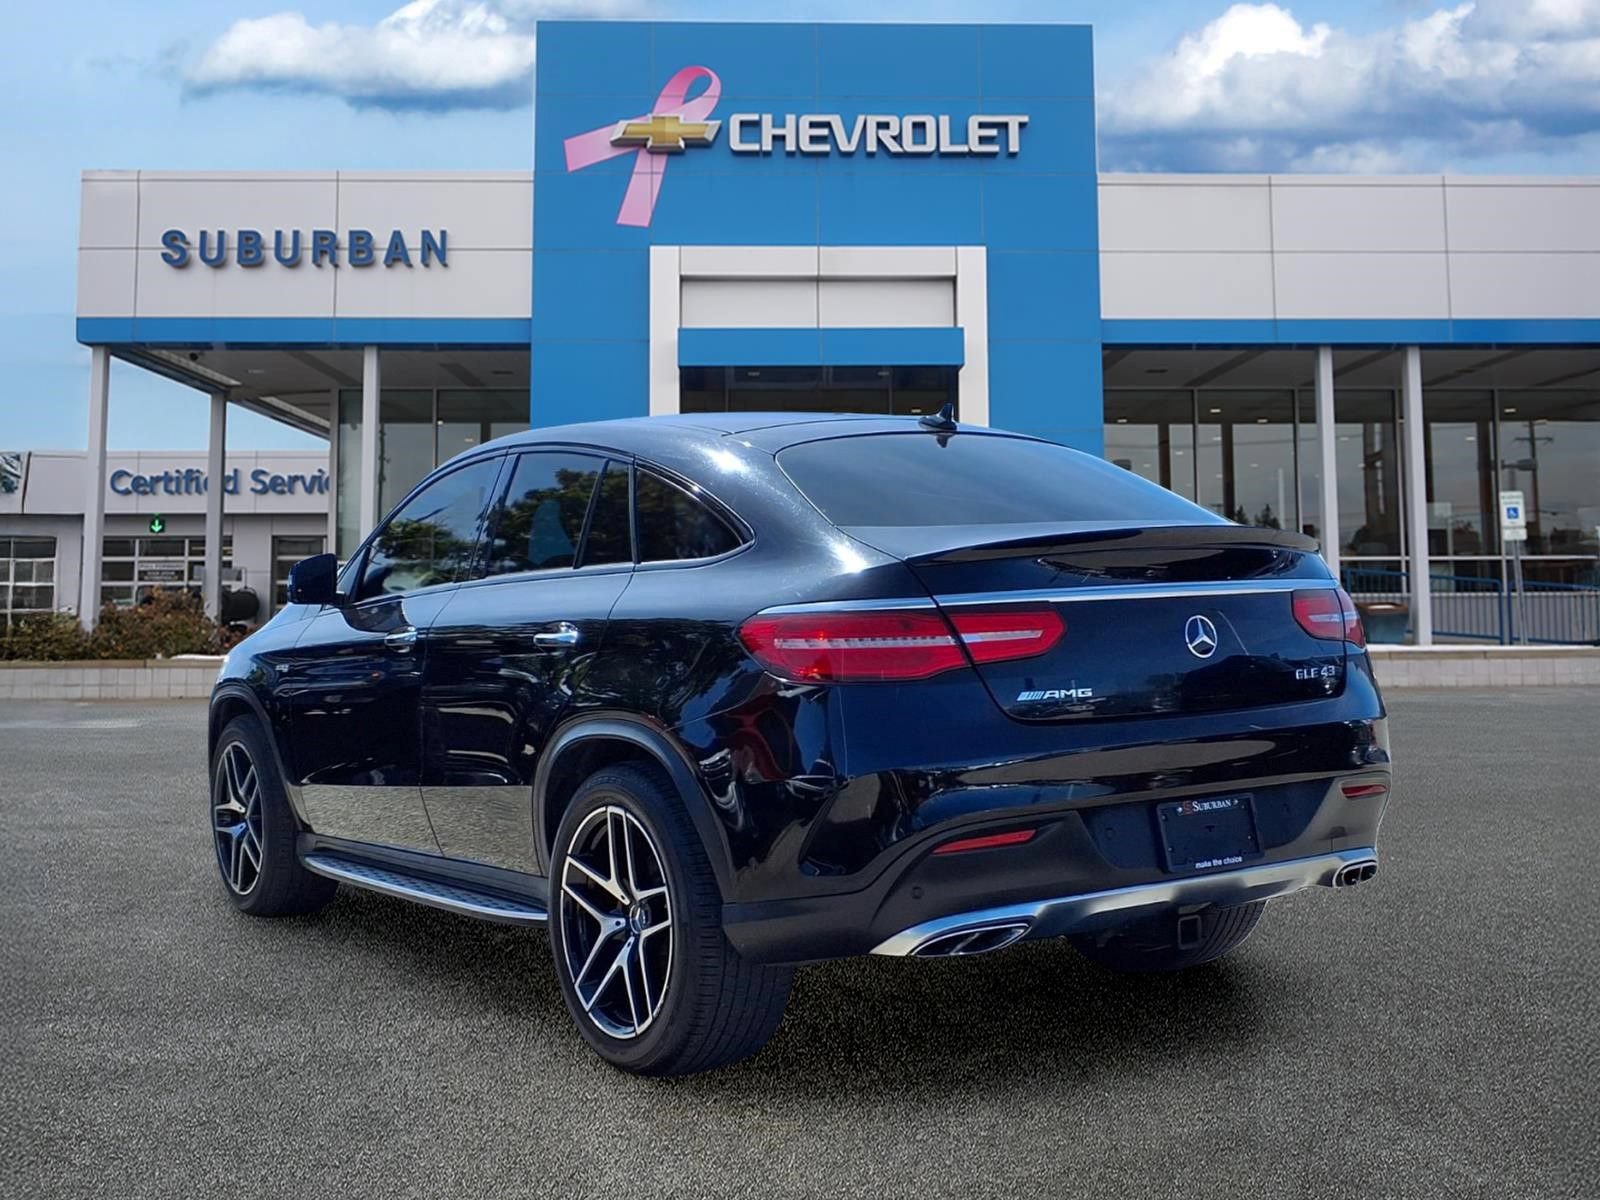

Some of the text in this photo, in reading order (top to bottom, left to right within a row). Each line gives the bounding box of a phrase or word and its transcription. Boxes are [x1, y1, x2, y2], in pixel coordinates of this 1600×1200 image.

[729, 112, 1029, 153] CHEVROLET
[161, 229, 449, 267] SUBURBAN
[110, 468, 239, 496] Certifid
[1295, 667, 1319, 680] GLE
[1042, 688, 1093, 700] AMG
